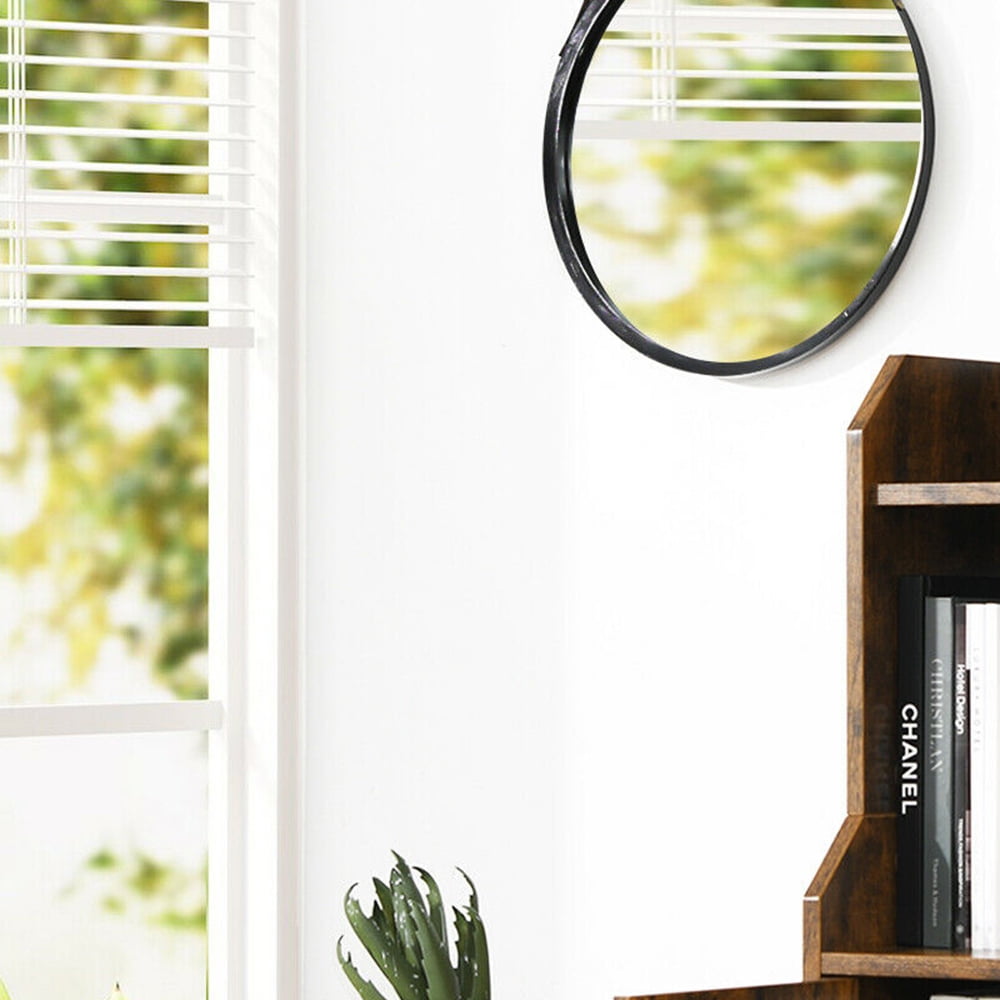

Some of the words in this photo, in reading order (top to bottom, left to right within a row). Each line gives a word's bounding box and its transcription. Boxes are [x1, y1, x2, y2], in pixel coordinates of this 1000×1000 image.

[956, 663, 967, 695] Hotel
[954, 696, 967, 735] Design
[901, 703, 918, 816] CHANEL
